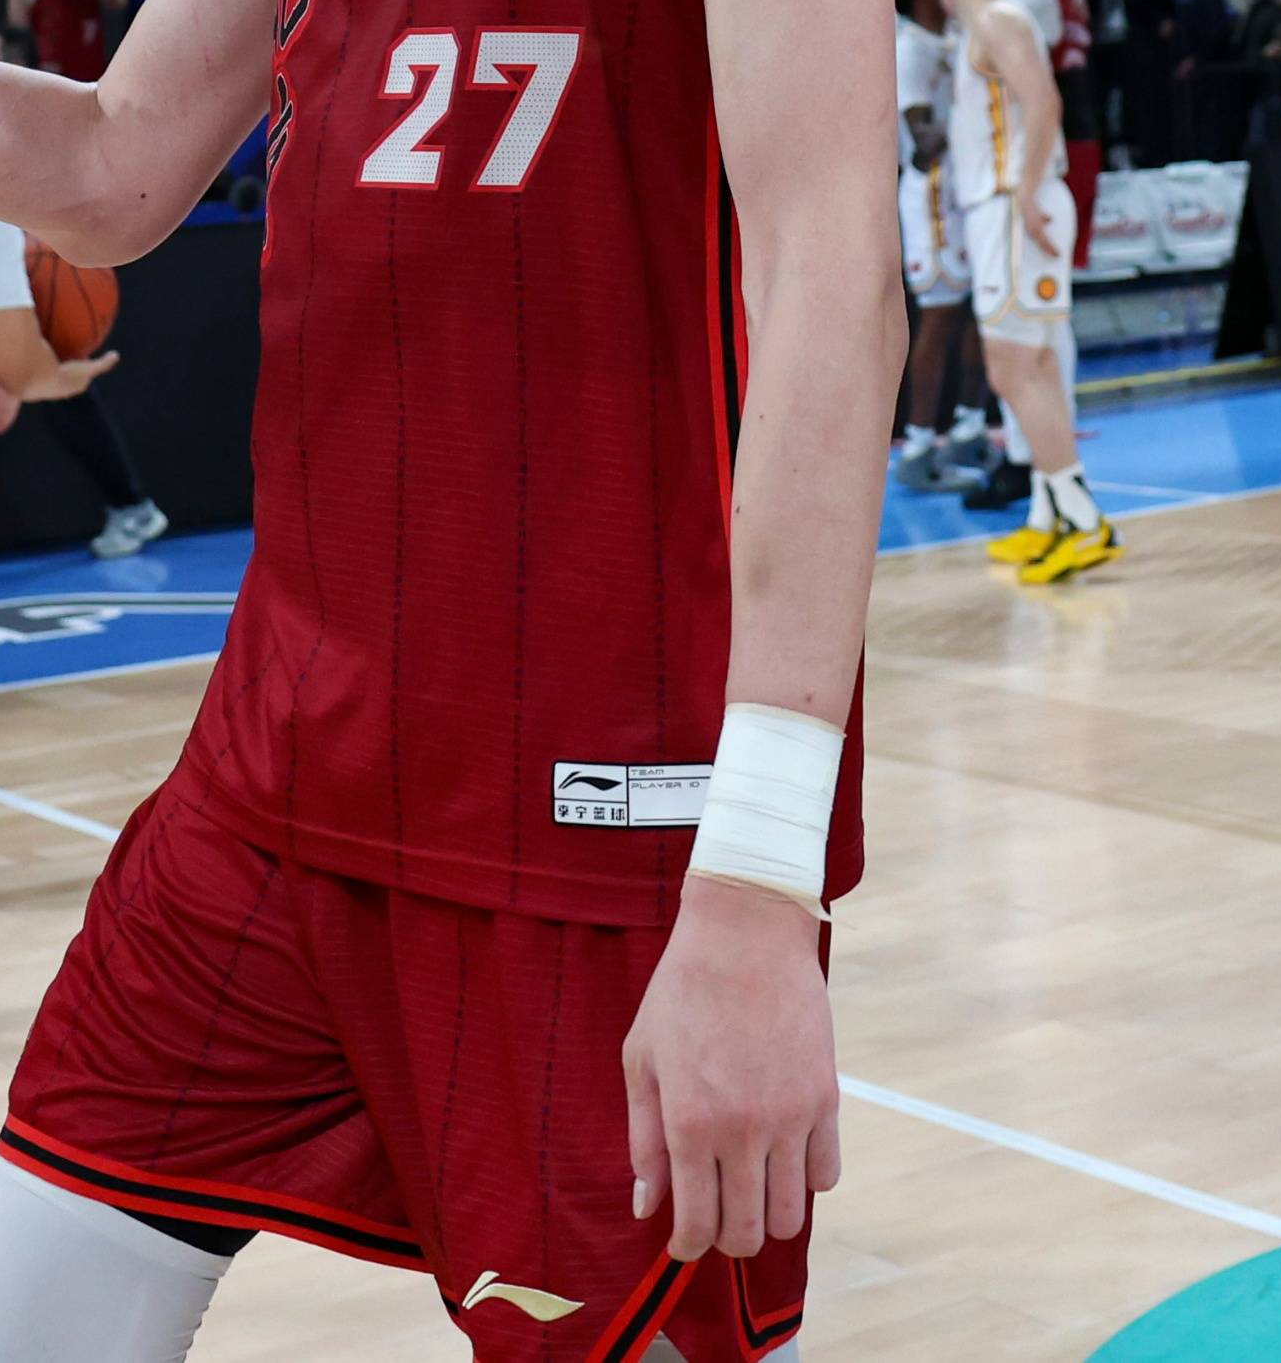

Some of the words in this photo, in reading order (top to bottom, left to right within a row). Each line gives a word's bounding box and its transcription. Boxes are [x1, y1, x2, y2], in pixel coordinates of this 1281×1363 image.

[357, 27, 584, 191] 27
[630, 768, 665, 776] TEAM
[630, 780, 682, 790] PLAYER
[689, 780, 701, 790] ID
[557, 804, 626, 821] 李宁篮球
